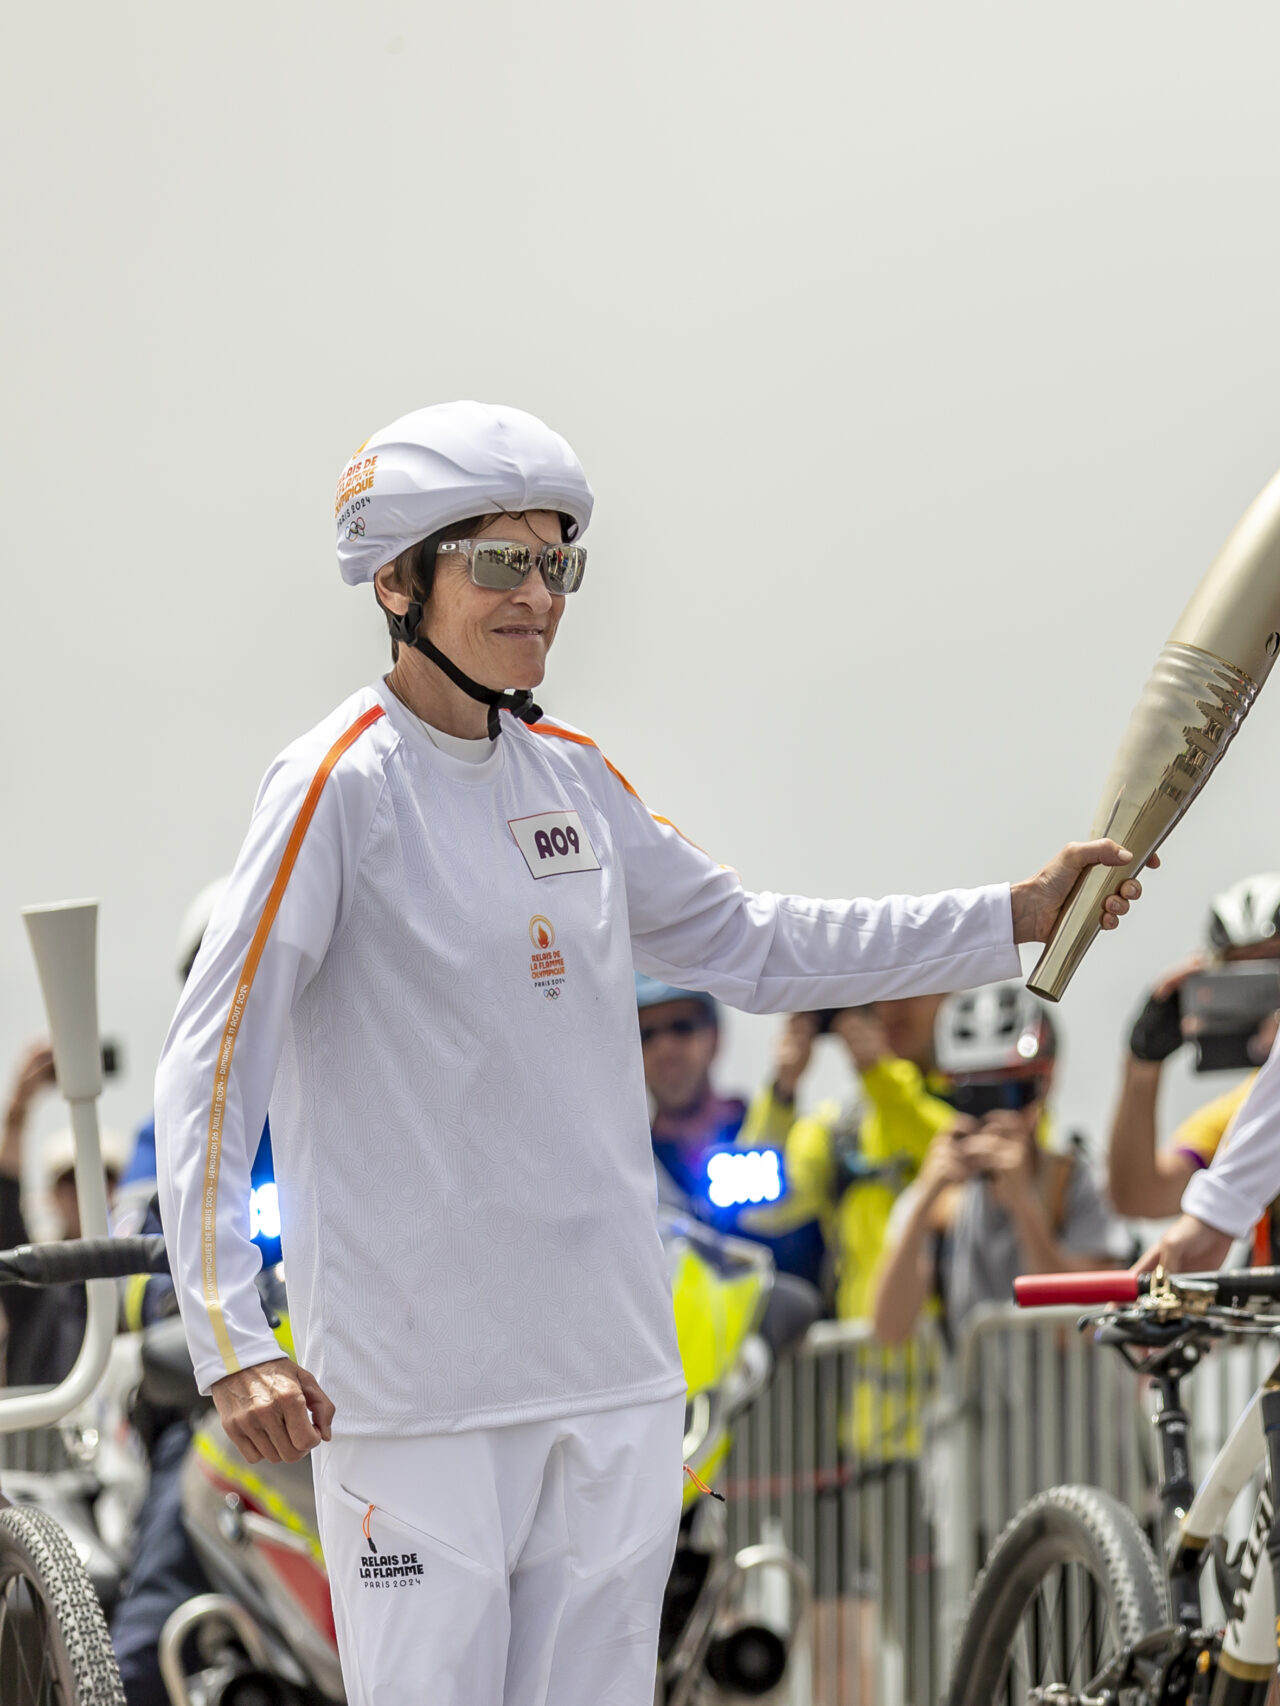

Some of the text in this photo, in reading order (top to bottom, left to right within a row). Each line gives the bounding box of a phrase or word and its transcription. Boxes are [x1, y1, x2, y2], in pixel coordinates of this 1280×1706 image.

[363, 455, 378, 469] DE
[350, 496, 371, 514] 2024
[531, 950, 561, 962] RELAIS DE
[530, 958, 564, 971] LA FLAMME
[237, 985, 248, 1004] 2024
[220, 1036, 233, 1074] DIMANCHE
[216, 1081, 225, 1102] 2024
[212, 1104, 222, 1130] JUILLET
[211, 1131, 219, 1141] 26
[208, 1142, 218, 1179] VENDREDI
[205, 1187, 214, 1208] 2024
[205, 1209, 213, 1231] PARIS
[205, 1232, 212, 1242] DE
[361, 1553, 418, 1567] RELAIS DE
[359, 1564, 424, 1578] LA FLAMME
[393, 1578, 421, 1588] 2024
